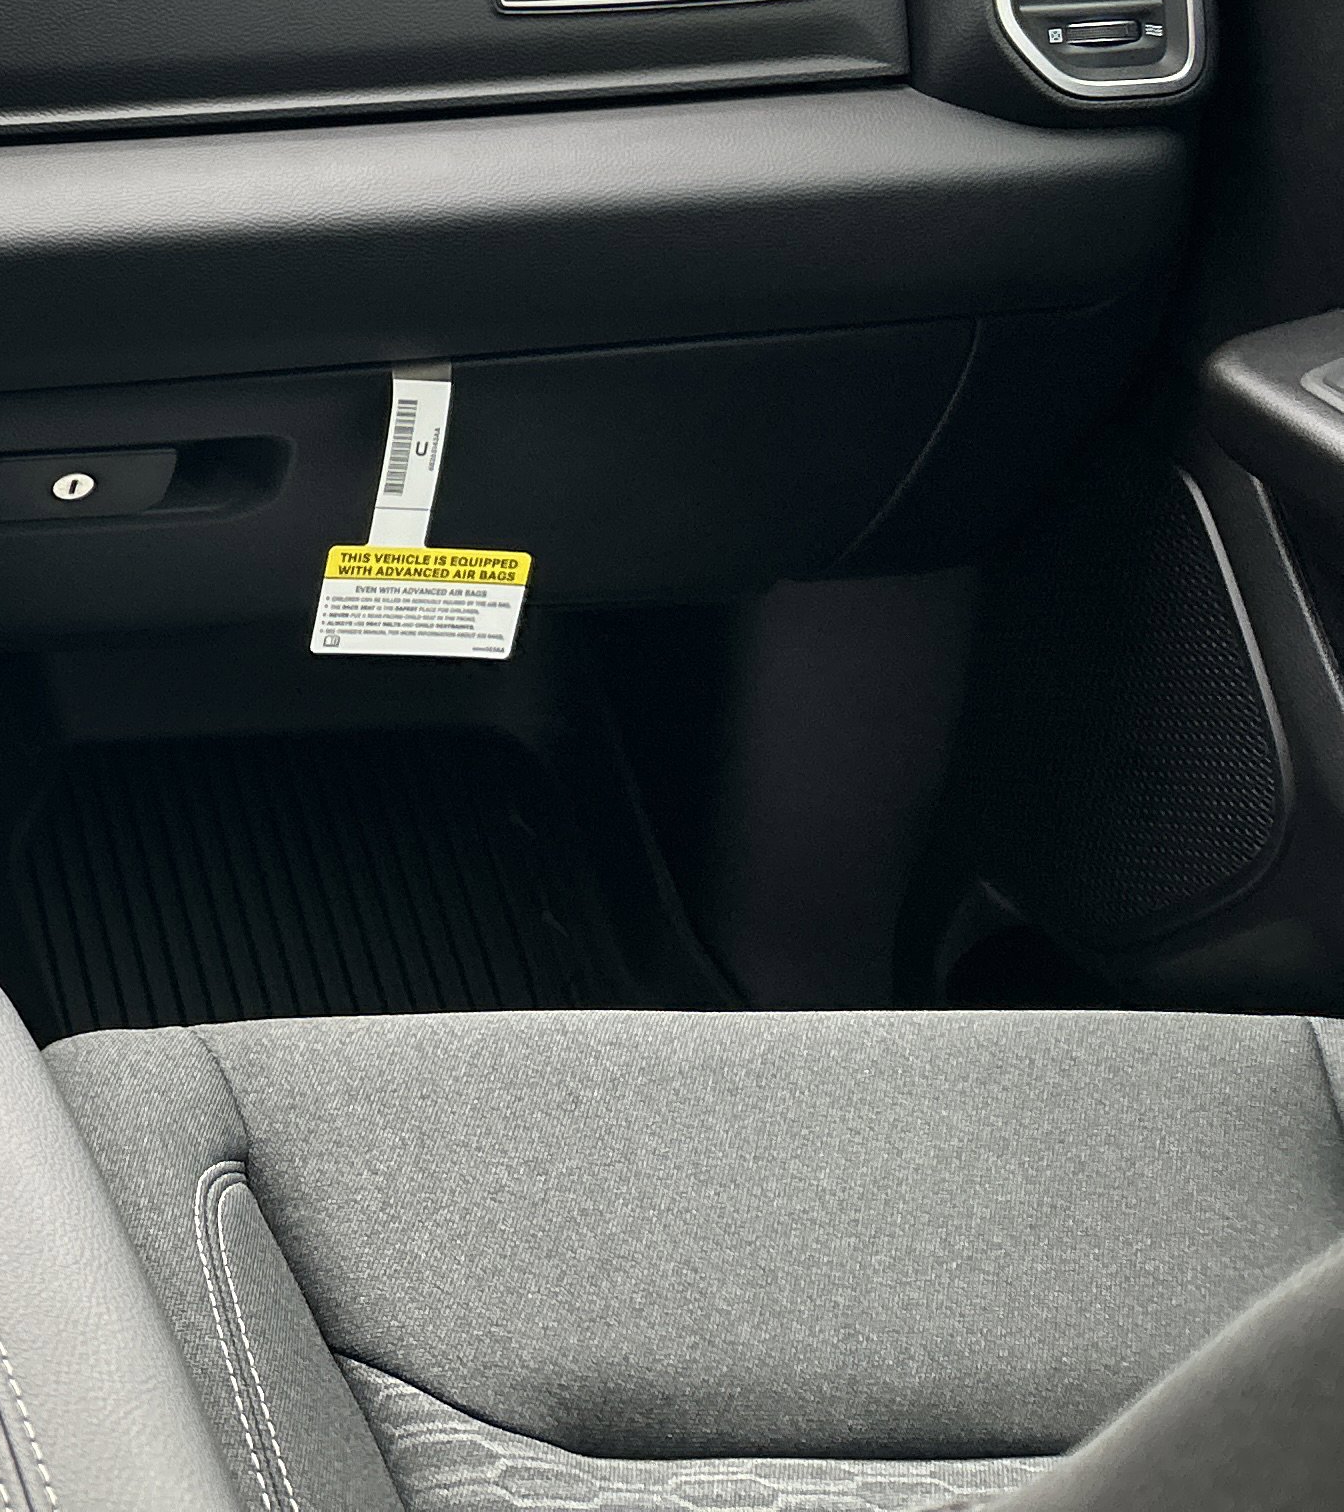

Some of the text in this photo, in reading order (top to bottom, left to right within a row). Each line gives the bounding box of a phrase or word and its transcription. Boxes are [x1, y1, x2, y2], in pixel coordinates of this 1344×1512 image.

[415, 441, 428, 457] U
[340, 552, 519, 570] THIS VEHICLE IS EQUIPPED
[338, 565, 516, 582] WITH ADVANCED AIR BAGS
[379, 586, 401, 595] WITH
[402, 587, 447, 597] ADVANCED
[449, 588, 464, 597] AIR
